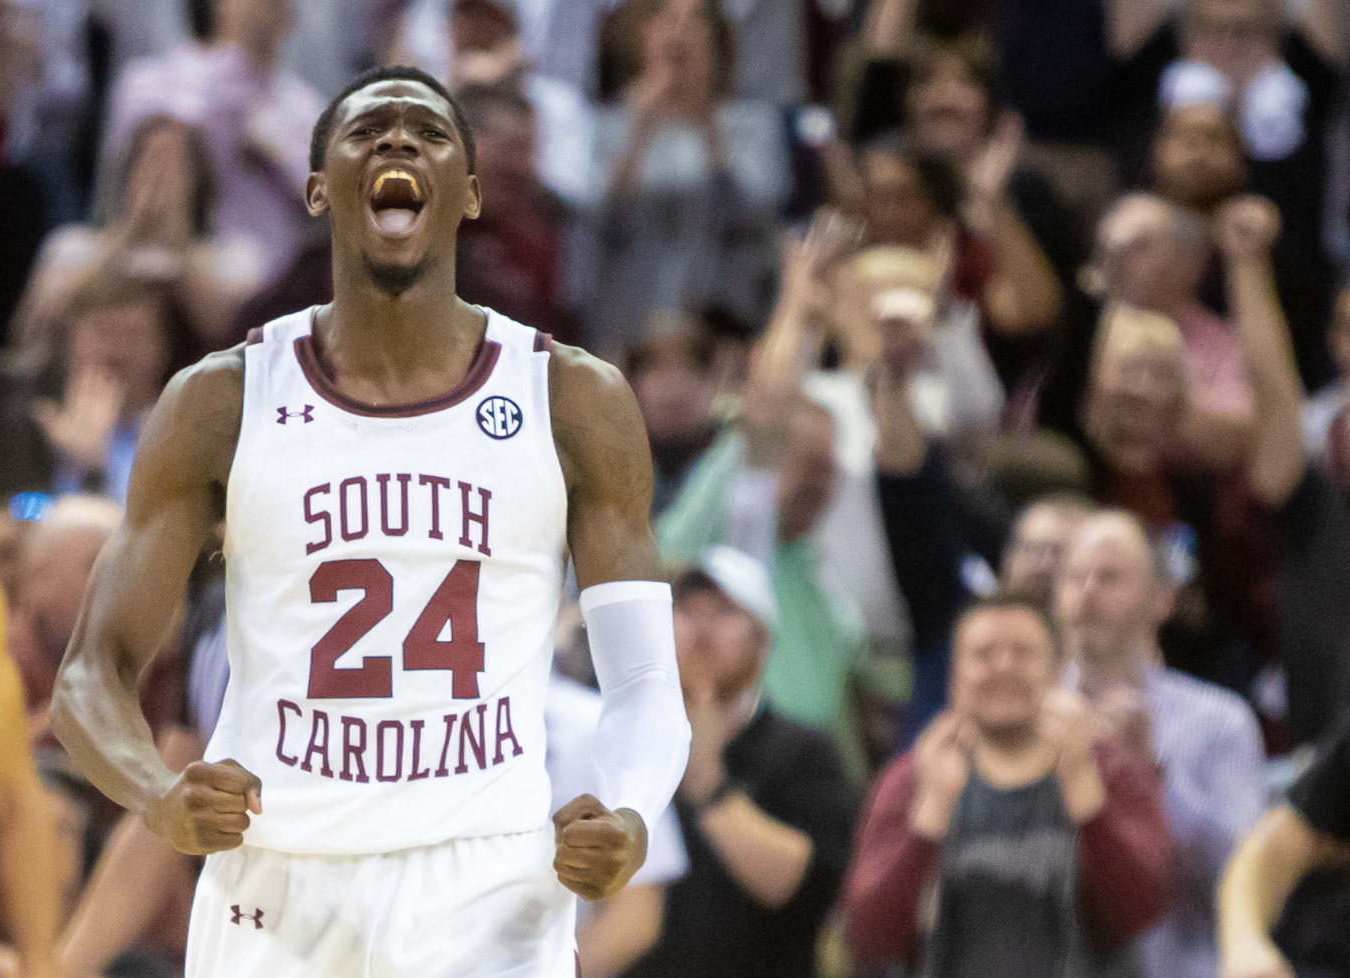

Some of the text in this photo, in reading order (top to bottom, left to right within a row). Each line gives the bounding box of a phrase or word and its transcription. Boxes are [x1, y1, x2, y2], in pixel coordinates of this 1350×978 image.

[478, 397, 522, 438] SEC
[303, 472, 493, 557] SOUTH
[306, 557, 486, 700] 24
[275, 696, 524, 784] CAROLINA
